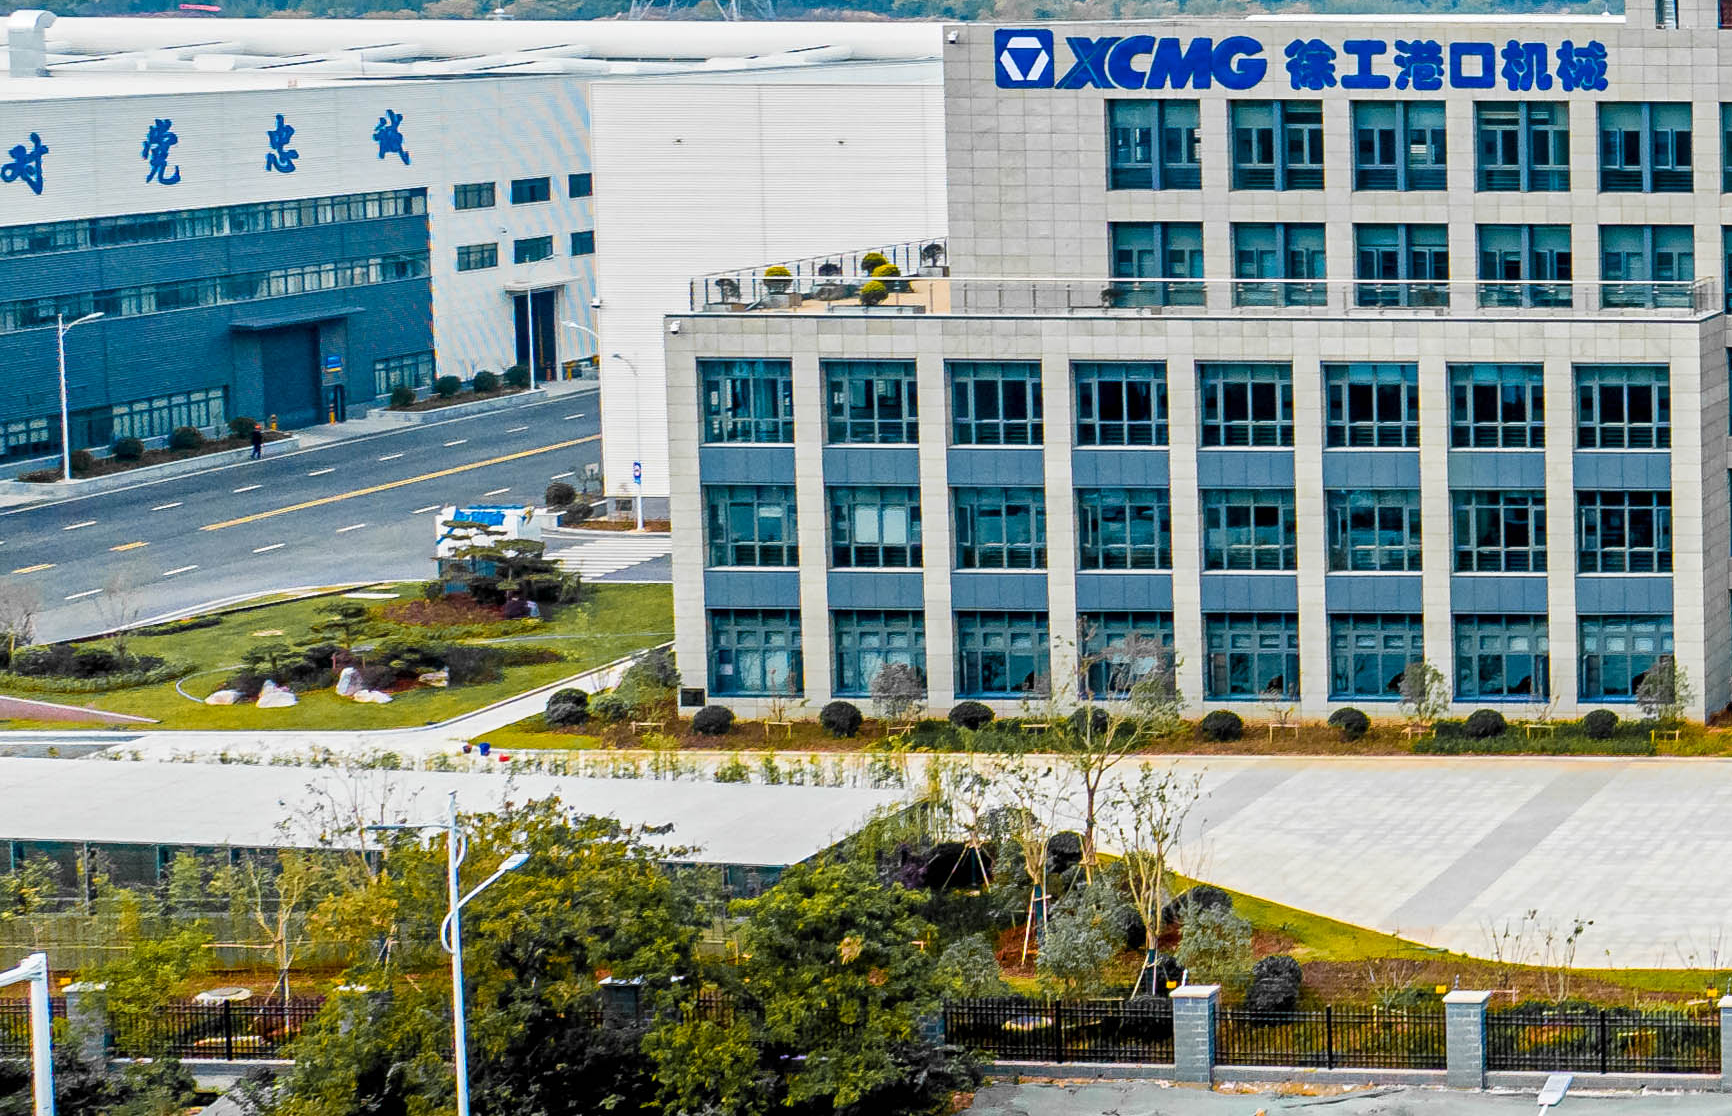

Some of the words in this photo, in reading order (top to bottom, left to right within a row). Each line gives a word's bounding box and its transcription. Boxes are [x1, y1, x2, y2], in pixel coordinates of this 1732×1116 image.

[1054, 34, 1267, 90] XCMG
[1285, 38, 1609, 92] 徐工港口机械
